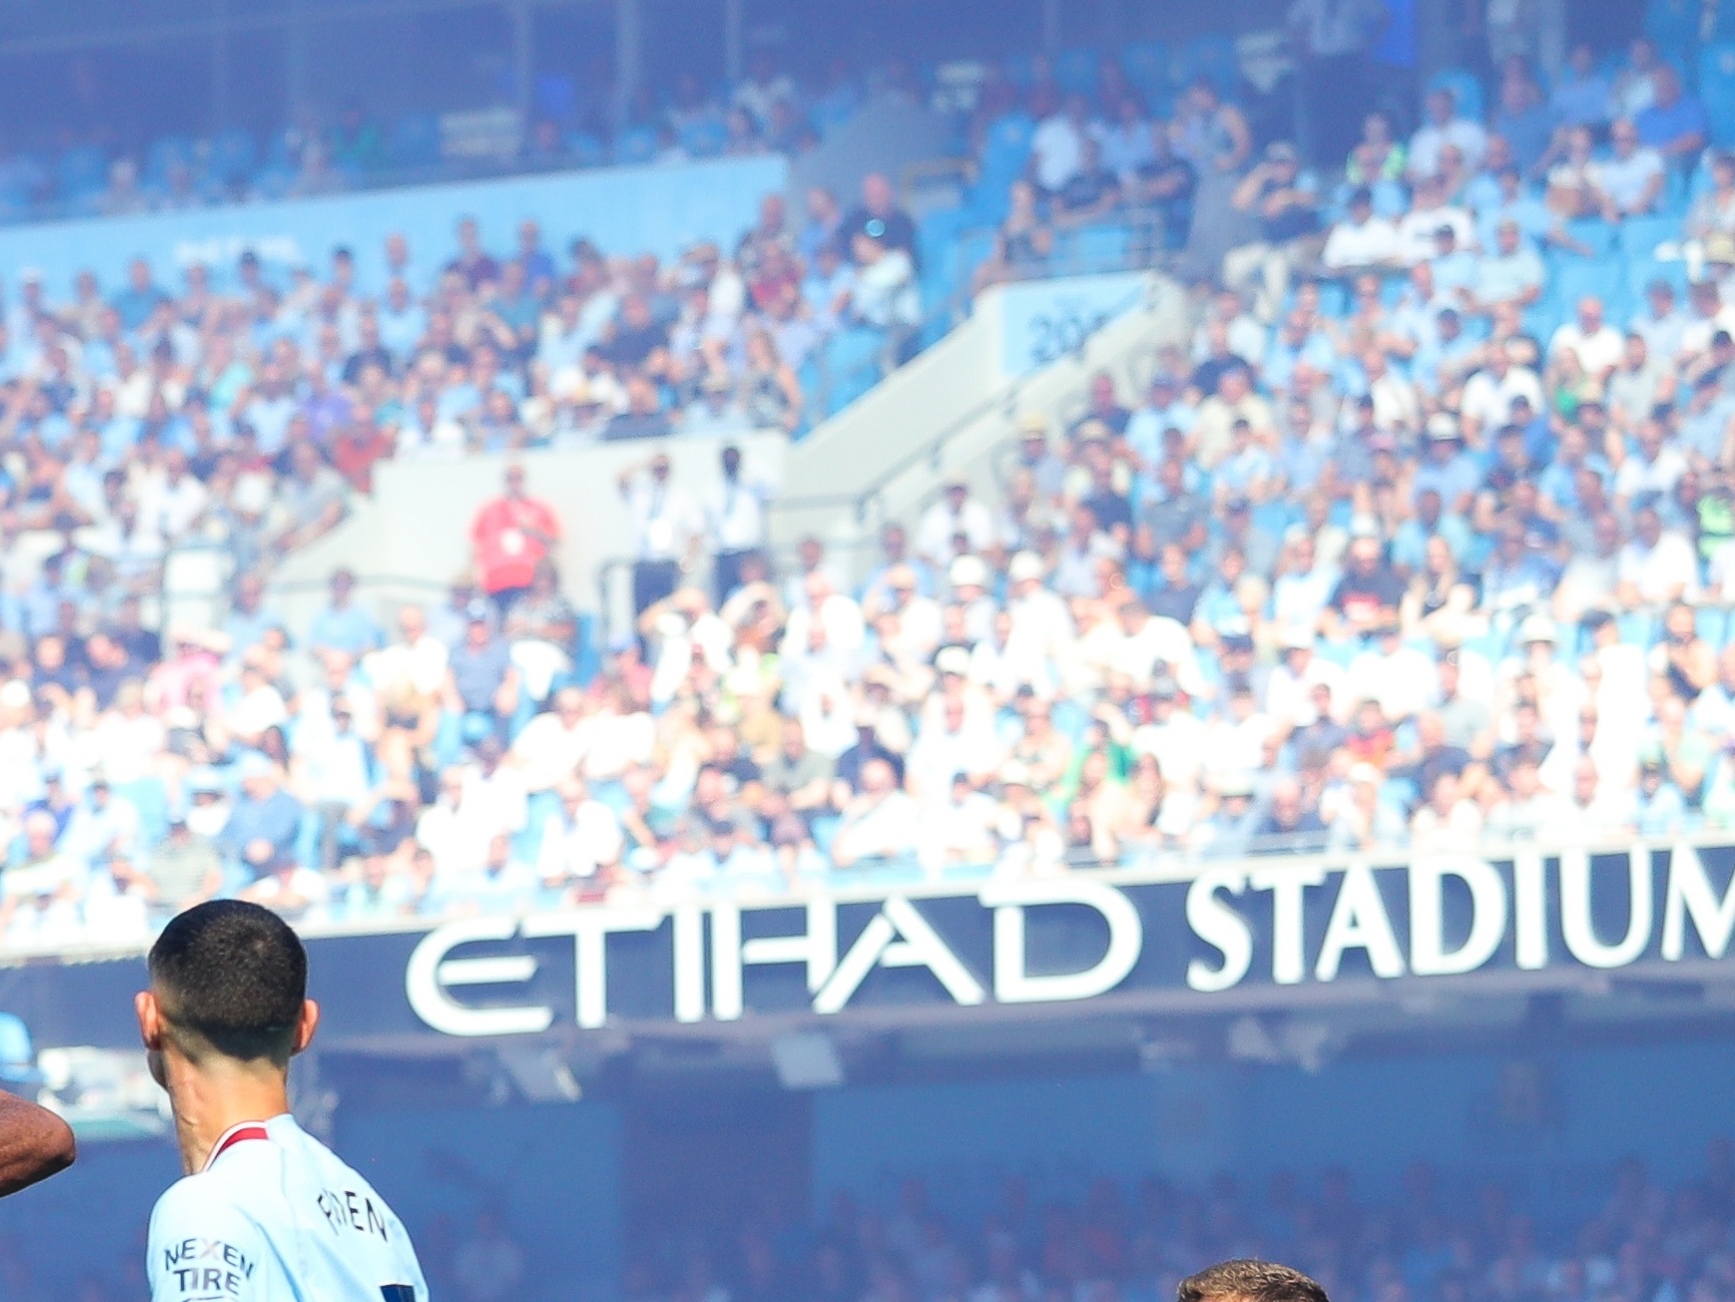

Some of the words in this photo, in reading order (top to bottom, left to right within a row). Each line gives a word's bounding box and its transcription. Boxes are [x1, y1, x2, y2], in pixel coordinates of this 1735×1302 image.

[405, 880, 1142, 1036] ETIHAD
[1185, 842, 1735, 992] STADIUM
[164, 1238, 255, 1281] NEXEN
[172, 1267, 241, 1296] TIRE
